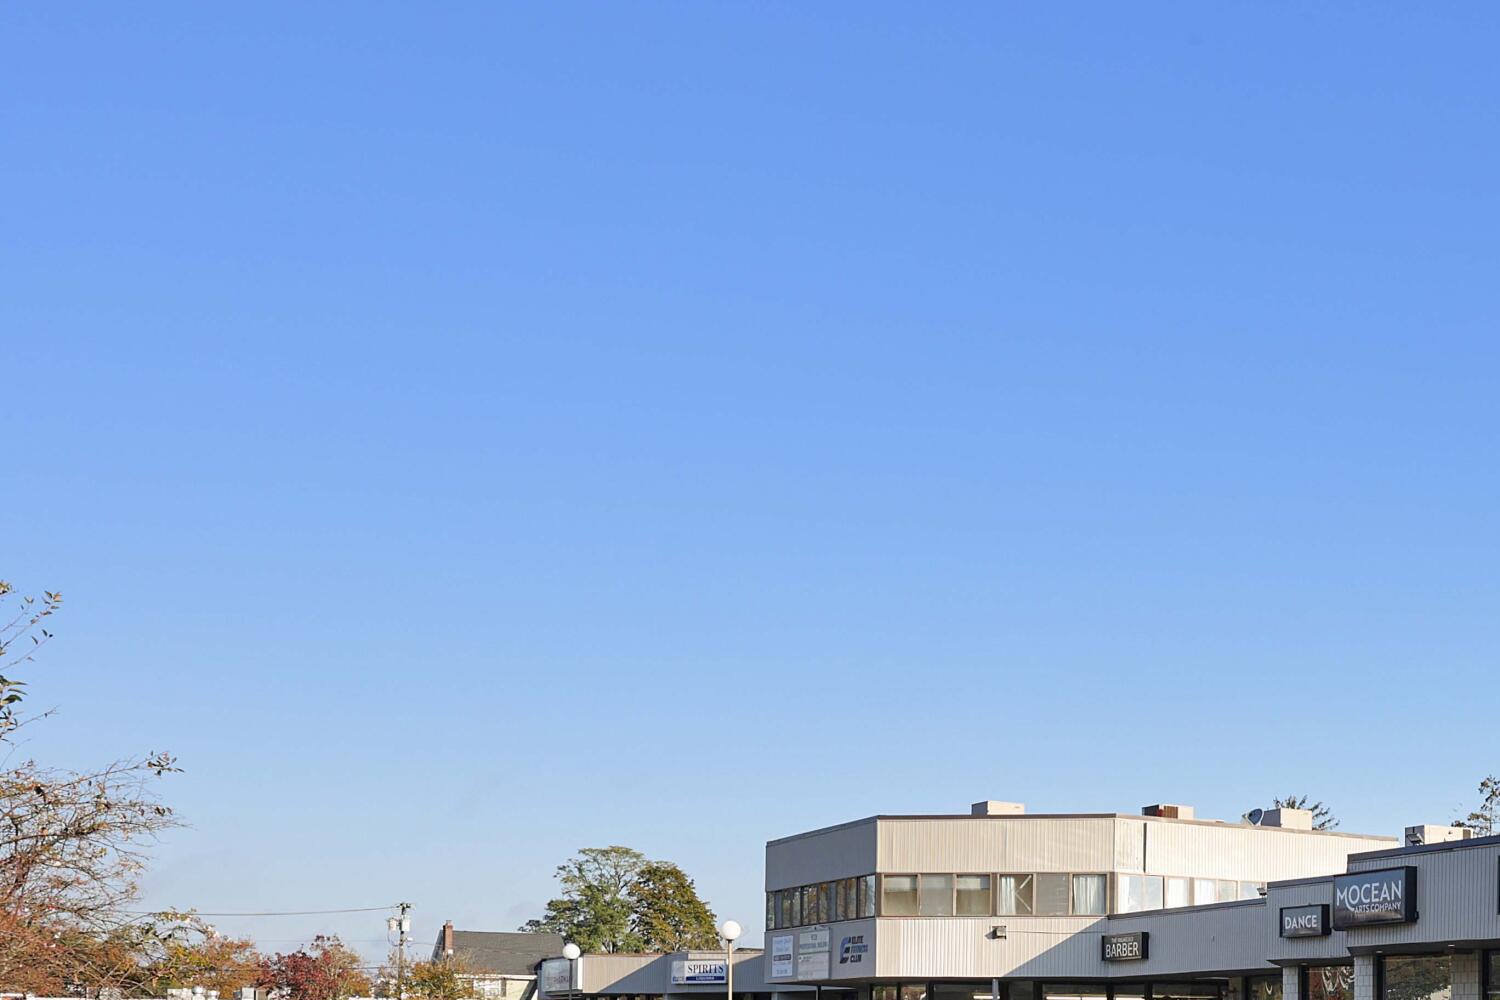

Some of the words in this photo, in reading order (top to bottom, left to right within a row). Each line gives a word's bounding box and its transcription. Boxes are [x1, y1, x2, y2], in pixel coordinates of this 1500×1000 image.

[1336, 880, 1401, 912] MOCEAN
[1354, 905, 1369, 914] ARTS
[1371, 902, 1401, 913] COMPANY
[1285, 915, 1317, 929] DANCE
[1106, 942, 1139, 958] BARBER
[687, 964, 724, 974] SPIRITS
